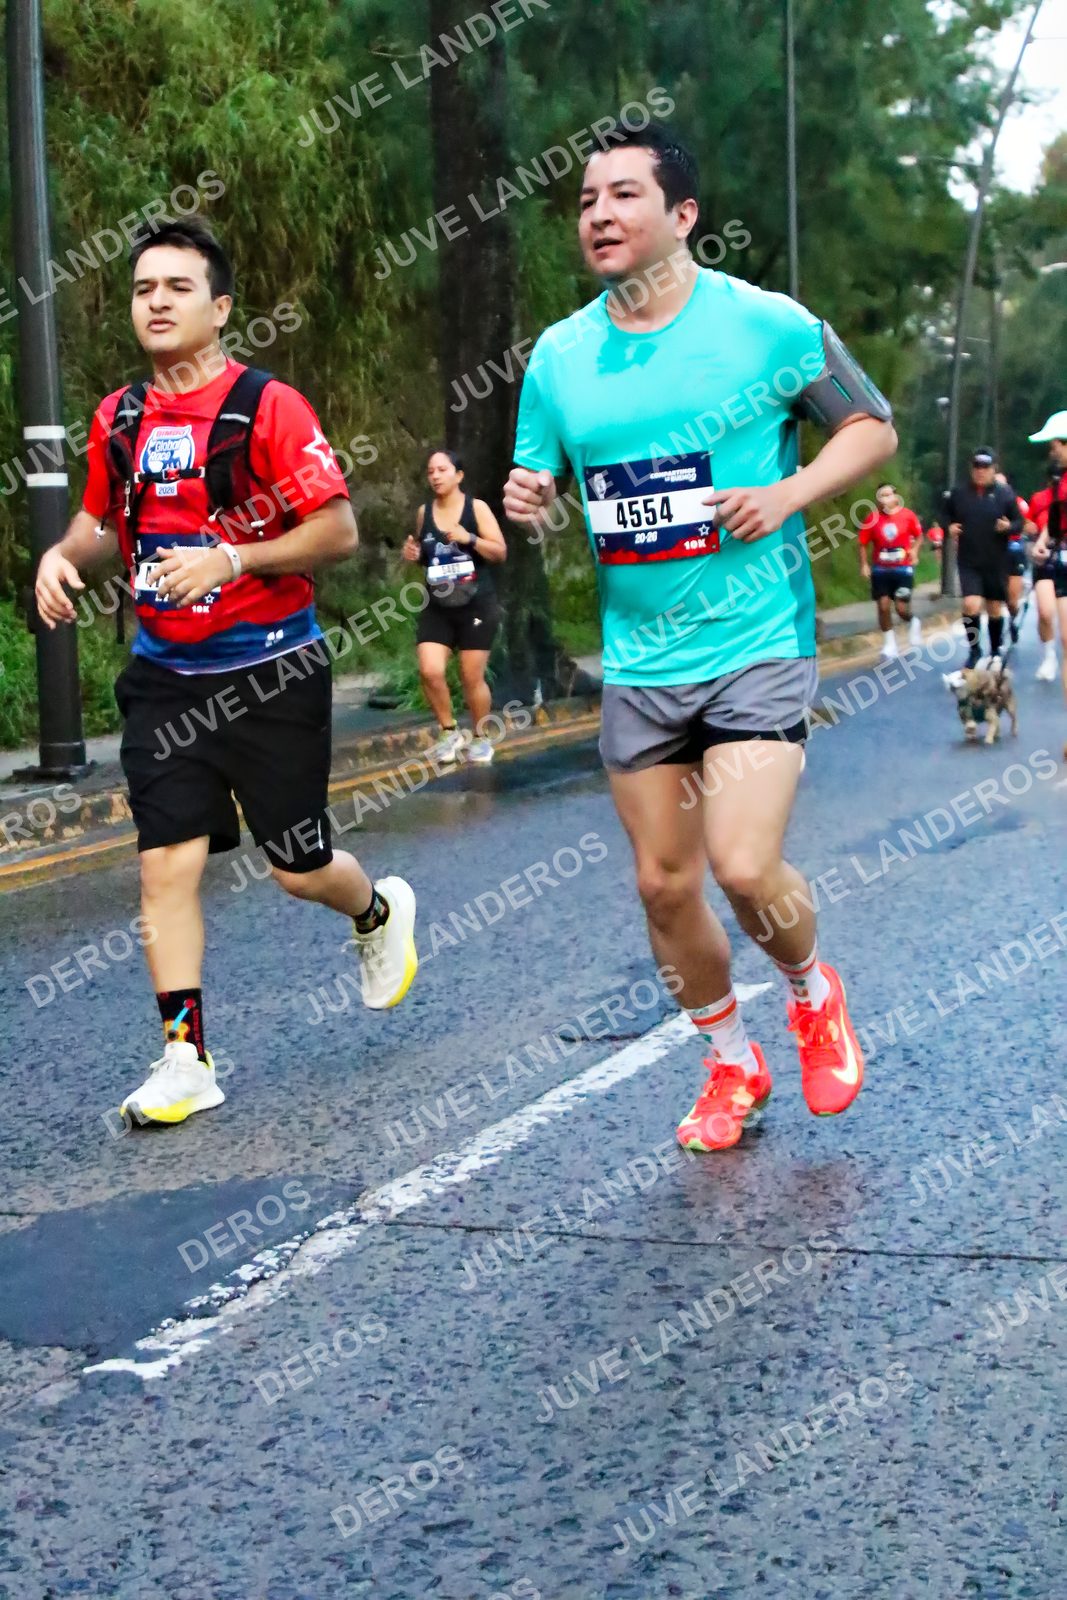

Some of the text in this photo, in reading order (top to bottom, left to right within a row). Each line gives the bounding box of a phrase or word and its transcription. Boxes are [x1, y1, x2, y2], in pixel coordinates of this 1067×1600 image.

[155, 440, 181, 452] Global
[150, 452, 171, 461] Race
[616, 496, 673, 528] 4554
[684, 538, 706, 550] 10K
[192, 605, 210, 613] 10K
